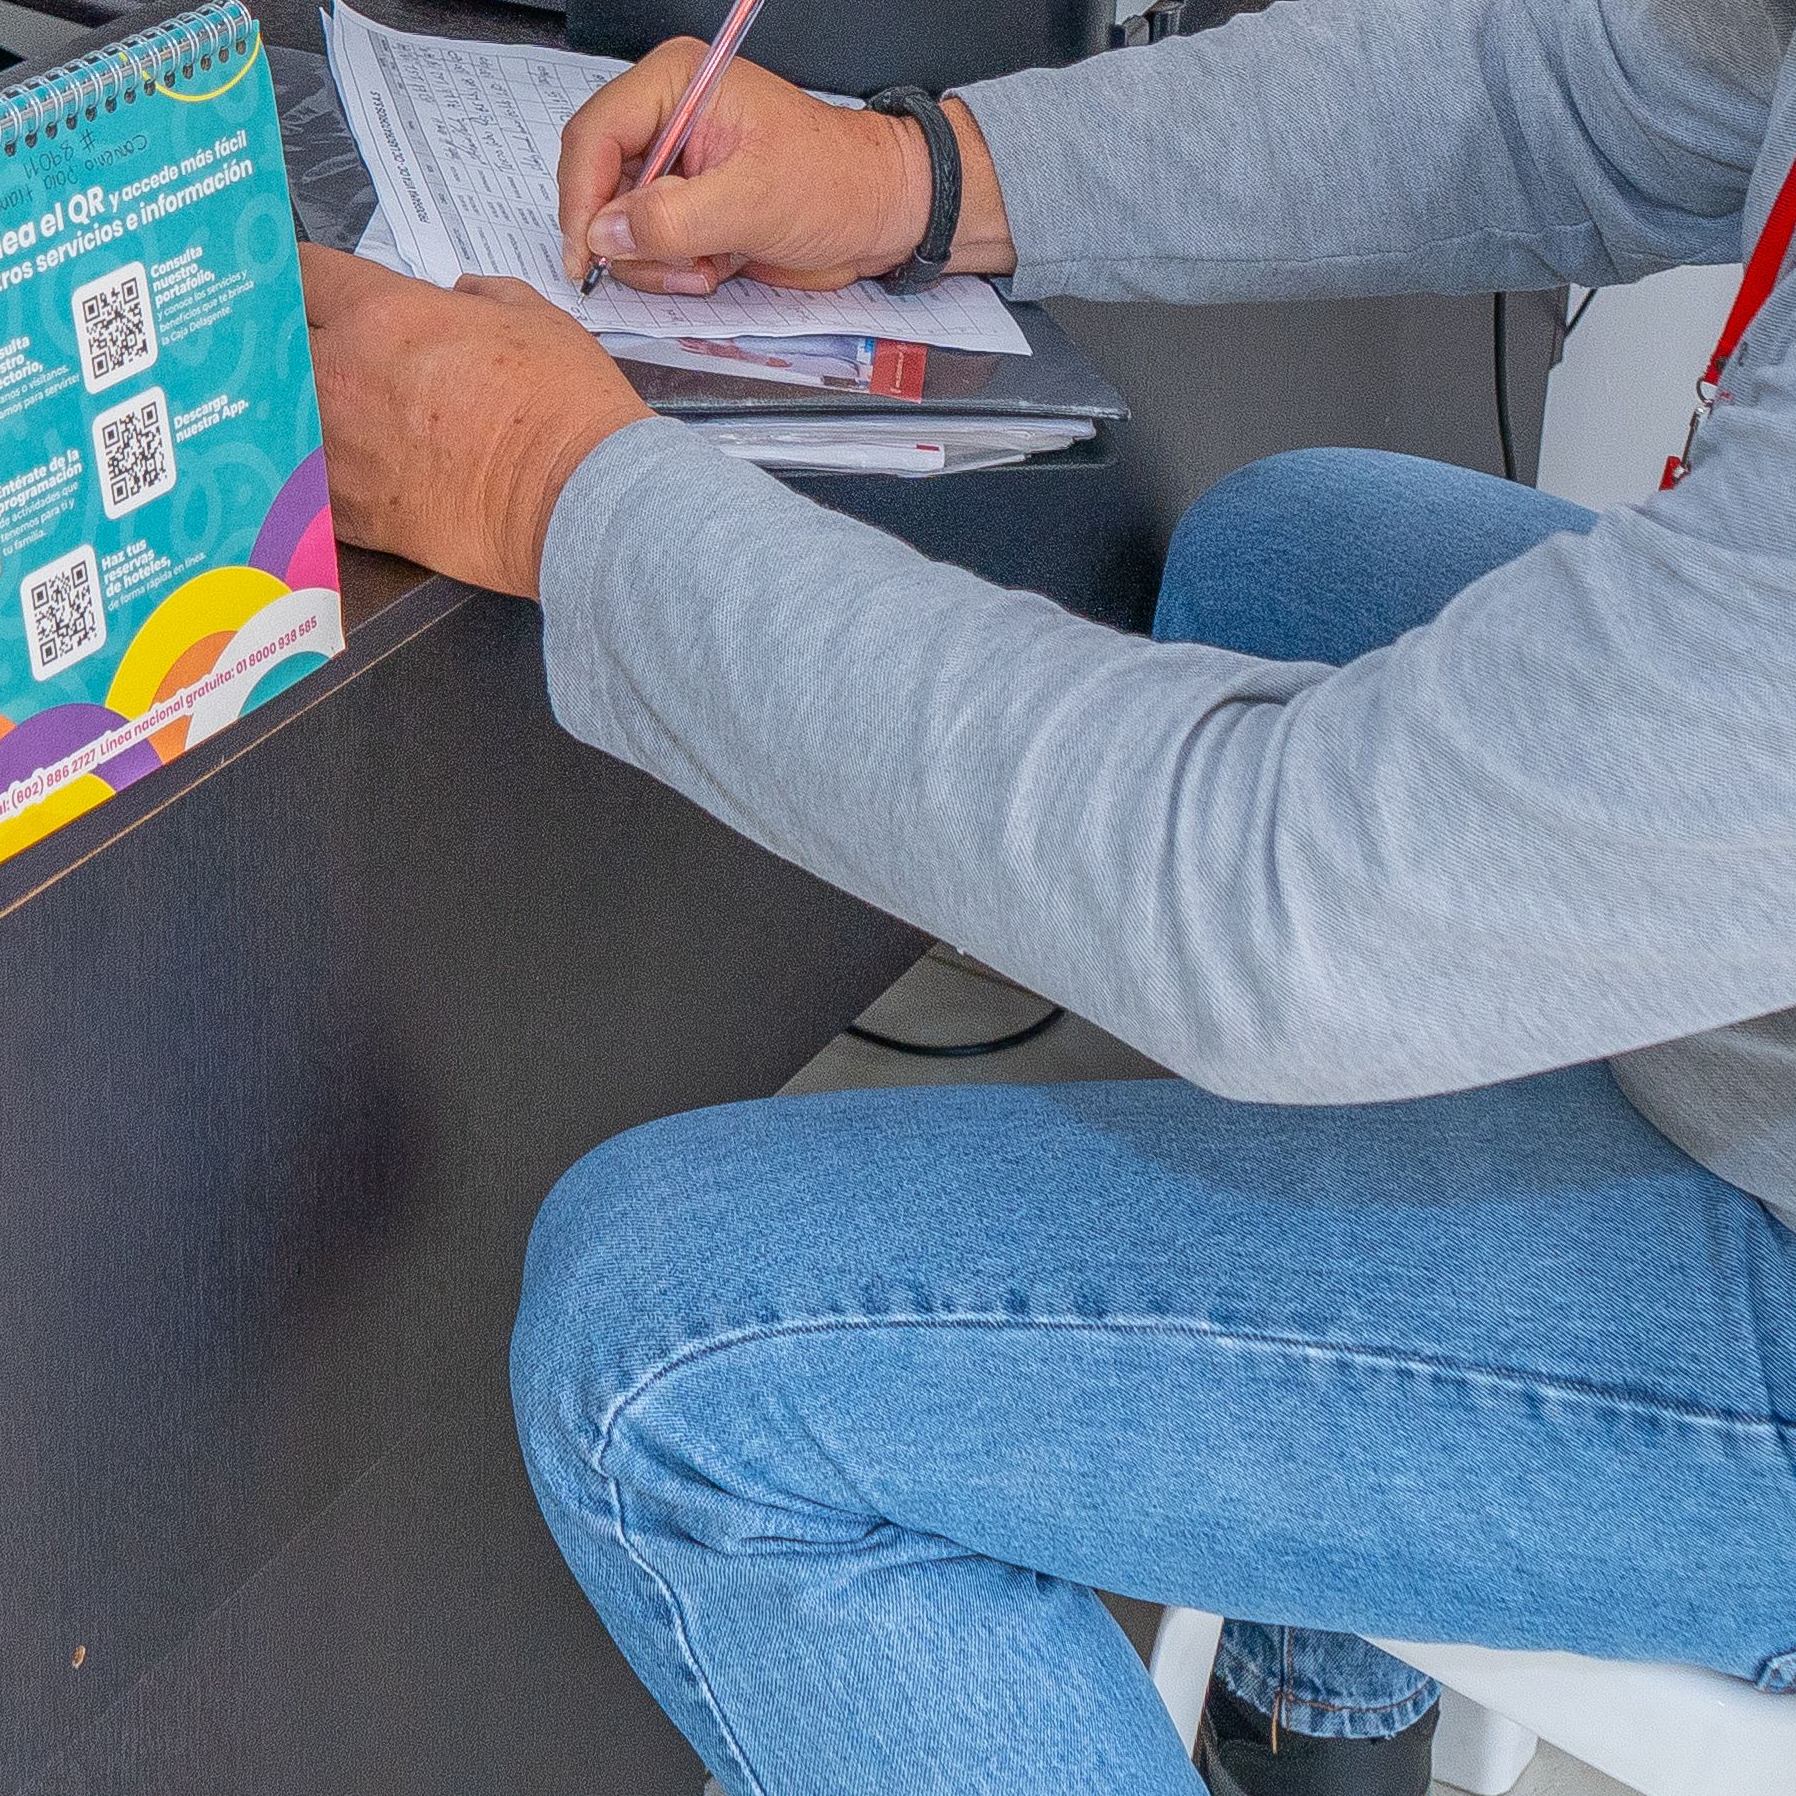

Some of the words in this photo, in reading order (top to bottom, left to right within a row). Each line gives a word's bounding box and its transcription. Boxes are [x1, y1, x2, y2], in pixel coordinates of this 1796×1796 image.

[40, 202, 65, 238] el
[68, 185, 104, 224] QR
[109, 190, 119, 213] y
[122, 165, 179, 202] accede
[180, 148, 214, 175] más
[214, 129, 247, 159] fácil
[35, 218, 124, 273] servicios
[126, 213, 139, 231] e
[140, 158, 254, 225] información
[150, 246, 203, 278] Consulta
[152, 263, 198, 292] nuestro
[155, 269, 215, 309] portafolio,
[159, 306, 201, 332] beneficios
[202, 298, 218, 313] que
[218, 294, 228, 303] te
[228, 280, 254, 300] brinda
[164, 296, 193, 316] conoce
[194, 290, 207, 301] los
[207, 273, 240, 295] servicios
[161, 335, 170, 345] la
[170, 327, 188, 342] Caja
[24, 392, 43, 409] para
[173, 394, 228, 430] Descarga
[175, 413, 220, 443] nuestra
[222, 399, 249, 420] App.
[49, 456, 65, 472] de
[66, 449, 80, 463] la
[11, 490, 61, 522] actividades
[61, 481, 79, 496] que
[0, 517, 39, 543] tenemos
[40, 505, 60, 524] para
[2, 546, 13, 556] tu
[101, 550, 125, 571] Haz
[126, 539, 147, 557] tus
[104, 549, 155, 584] reservas
[106, 582, 122, 597] de
[123, 556, 171, 589] hoteles,
[108, 599, 120, 611] de
[120, 586, 146, 605] forma
[173, 564, 184, 575] en
[46, 765, 70, 788] 886
[71, 748, 97, 774] 2727
[99, 729, 133, 756] Línea
[134, 697, 184, 736] nacional
[185, 670, 235, 708] gratuita:
[235, 660, 248, 675] 01
[249, 642, 277, 666] 8000
[277, 629, 298, 651] 938
[298, 615, 318, 638] 585
